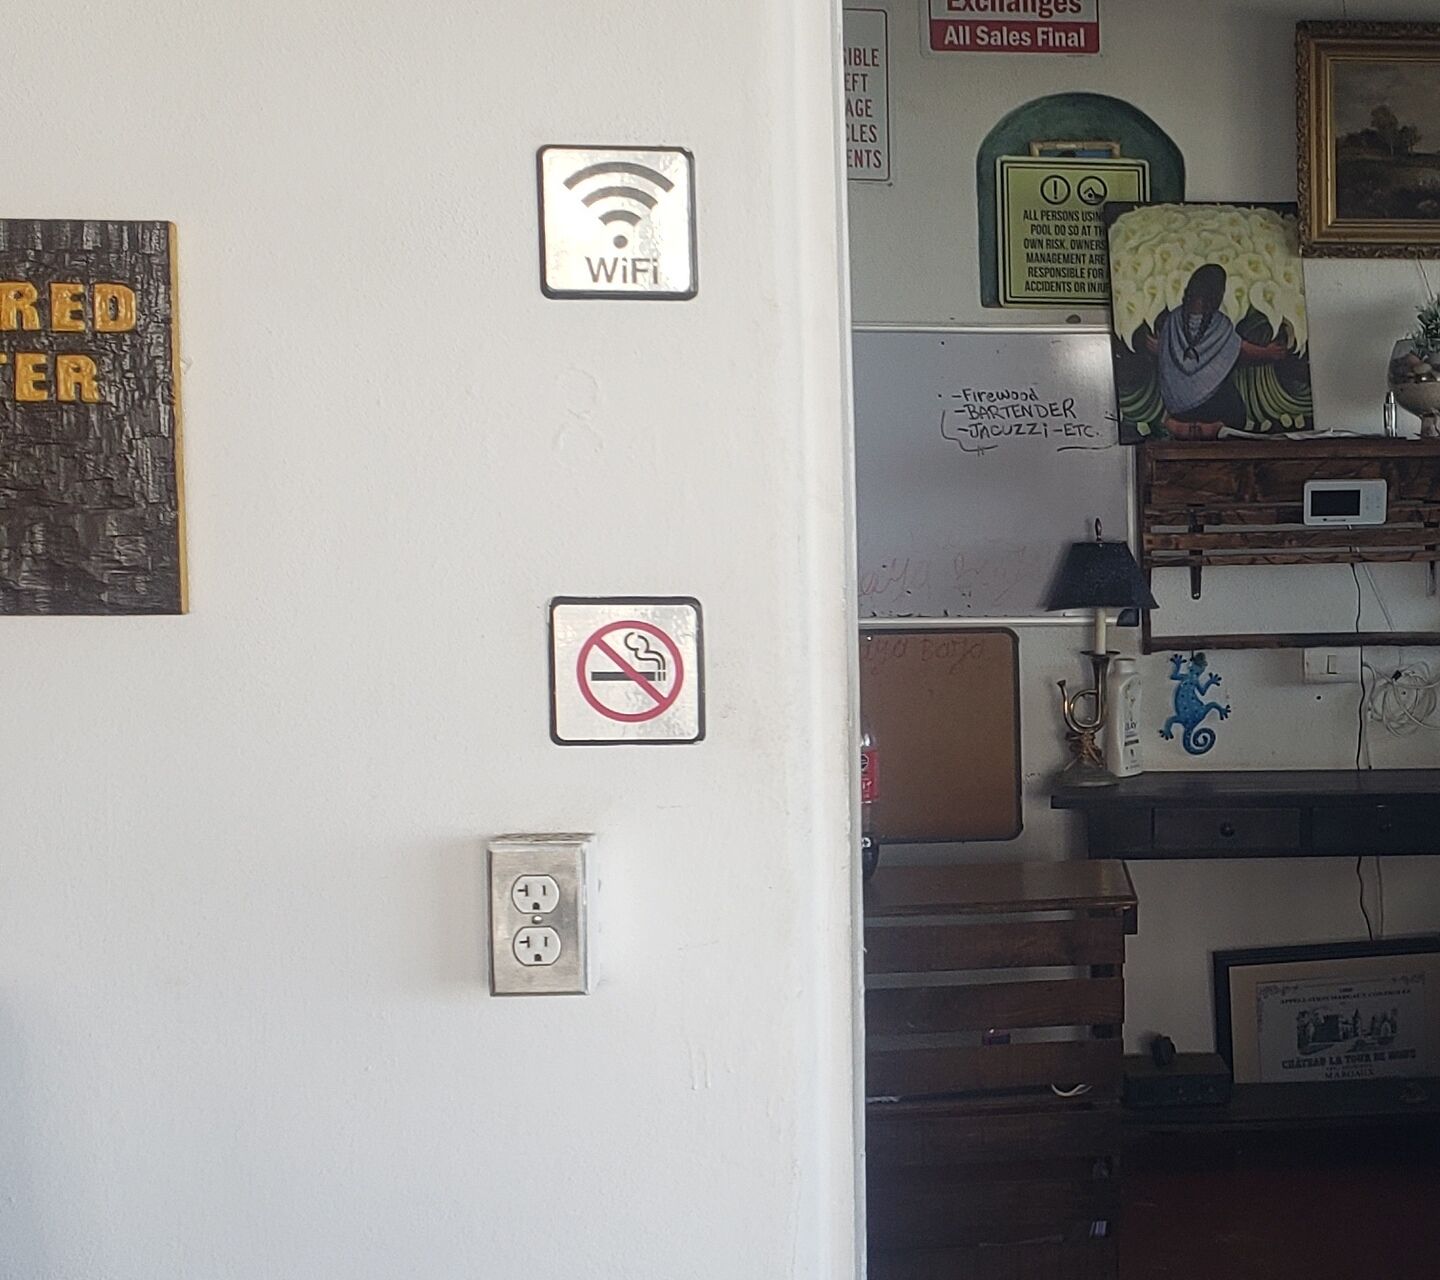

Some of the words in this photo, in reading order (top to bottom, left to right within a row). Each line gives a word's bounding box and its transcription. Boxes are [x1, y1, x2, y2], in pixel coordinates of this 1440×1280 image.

[944, 25, 970, 46] All
[976, 25, 1032, 47] Sales
[1037, 27, 1086, 48] Final
[843, 47, 880, 67] IBLE
[1023, 210, 1039, 221] ALL
[1040, 210, 1080, 221] PERSONS
[1031, 224, 1052, 235] POOL
[1054, 224, 1066, 236] DO
[1067, 225, 1079, 236] SO
[1081, 225, 1091, 236] AT
[1023, 238, 1044, 249] OWN
[1026, 252, 1086, 264] MANAGEMENT
[1088, 254, 1105, 265] ARE
[585, 256, 658, 284] WiFi
[1028, 267, 1085, 278] RESPONSIBLE
[1087, 268, 1104, 279] FOR
[1025, 281, 1072, 292] ACCIDENTS
[1074, 281, 1086, 293] OR
[0, 352, 100, 402] ER
